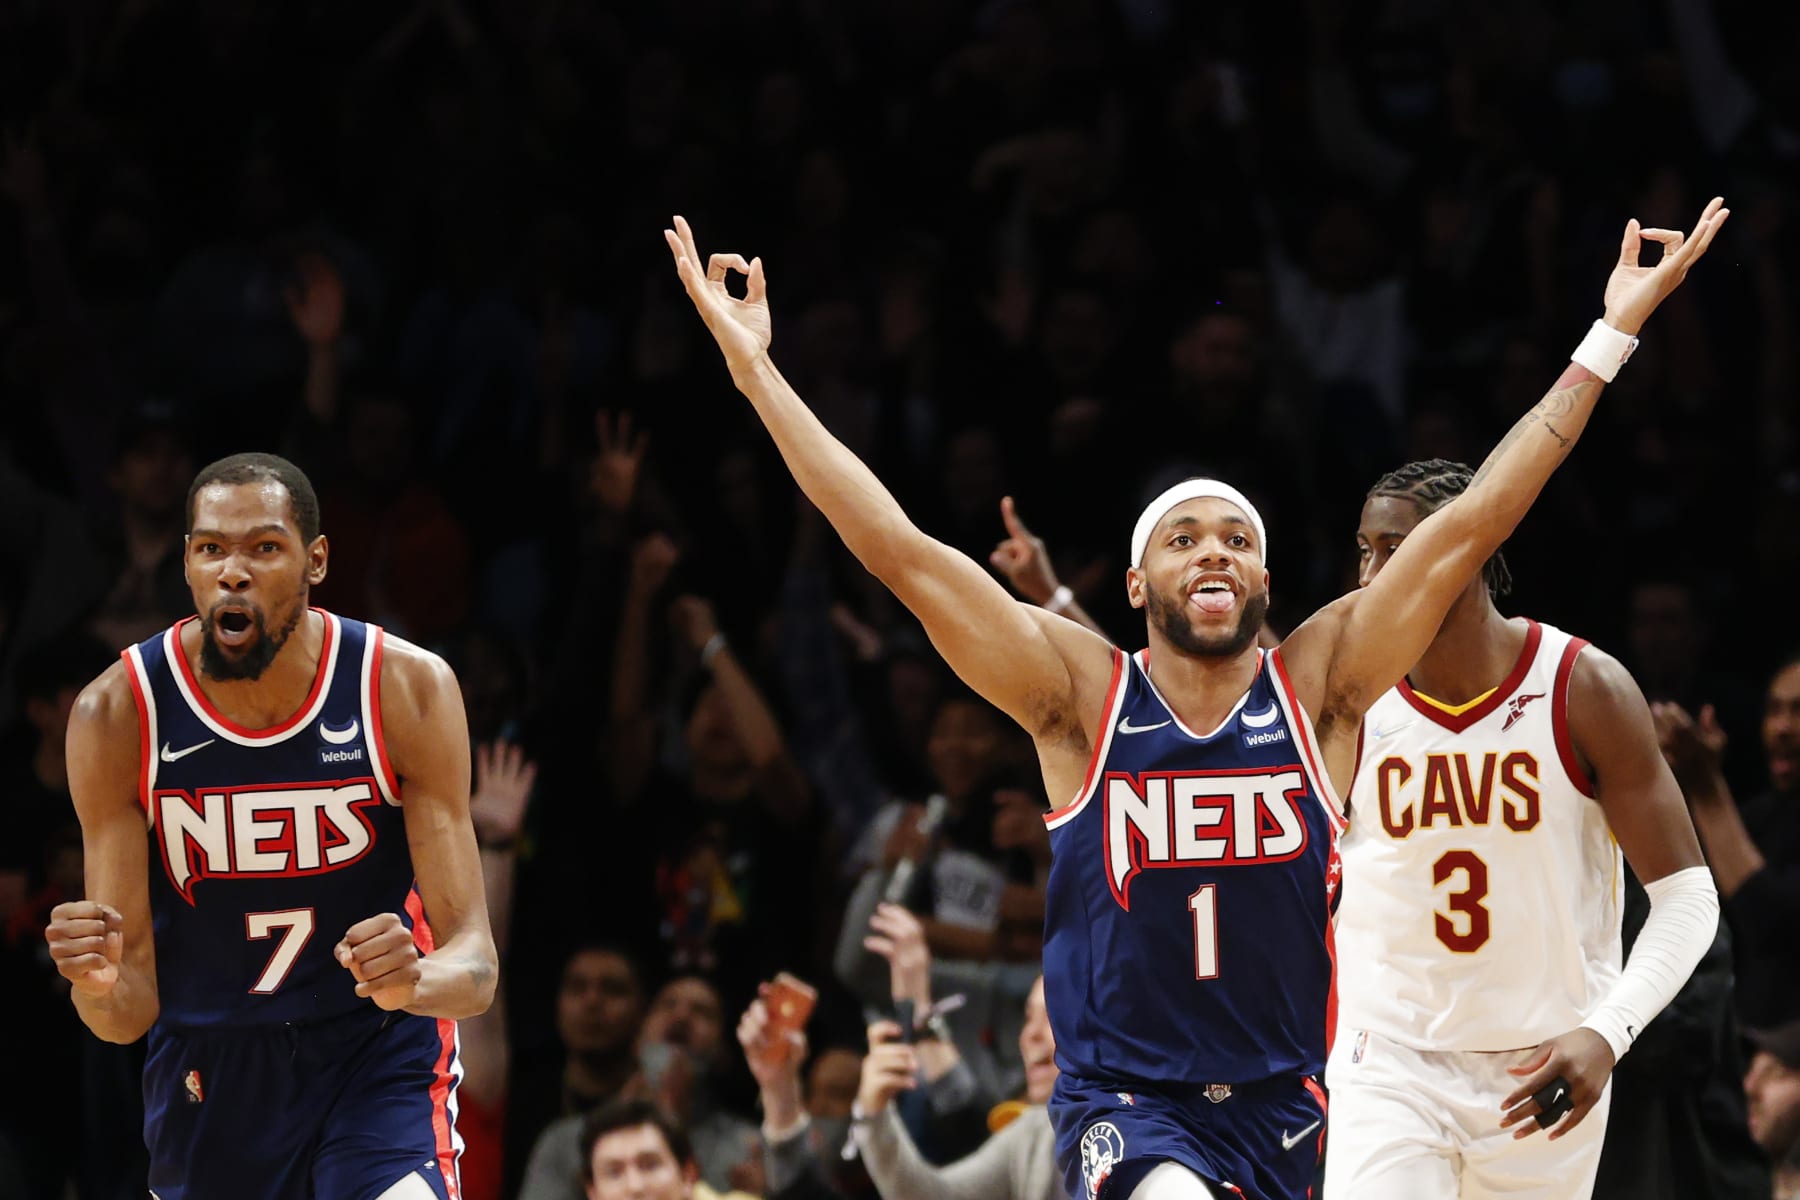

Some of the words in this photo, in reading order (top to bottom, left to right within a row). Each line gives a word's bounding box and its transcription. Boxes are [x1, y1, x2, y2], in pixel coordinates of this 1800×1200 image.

[321, 749, 361, 763] Webull
[1246, 729, 1285, 746] Webull
[156, 780, 378, 900] NETS
[1106, 768, 1306, 904] NETS
[1377, 751, 1541, 839] CAVS
[1188, 884, 1219, 981] 1
[1432, 850, 1491, 954] 3
[245, 907, 316, 994] 7
